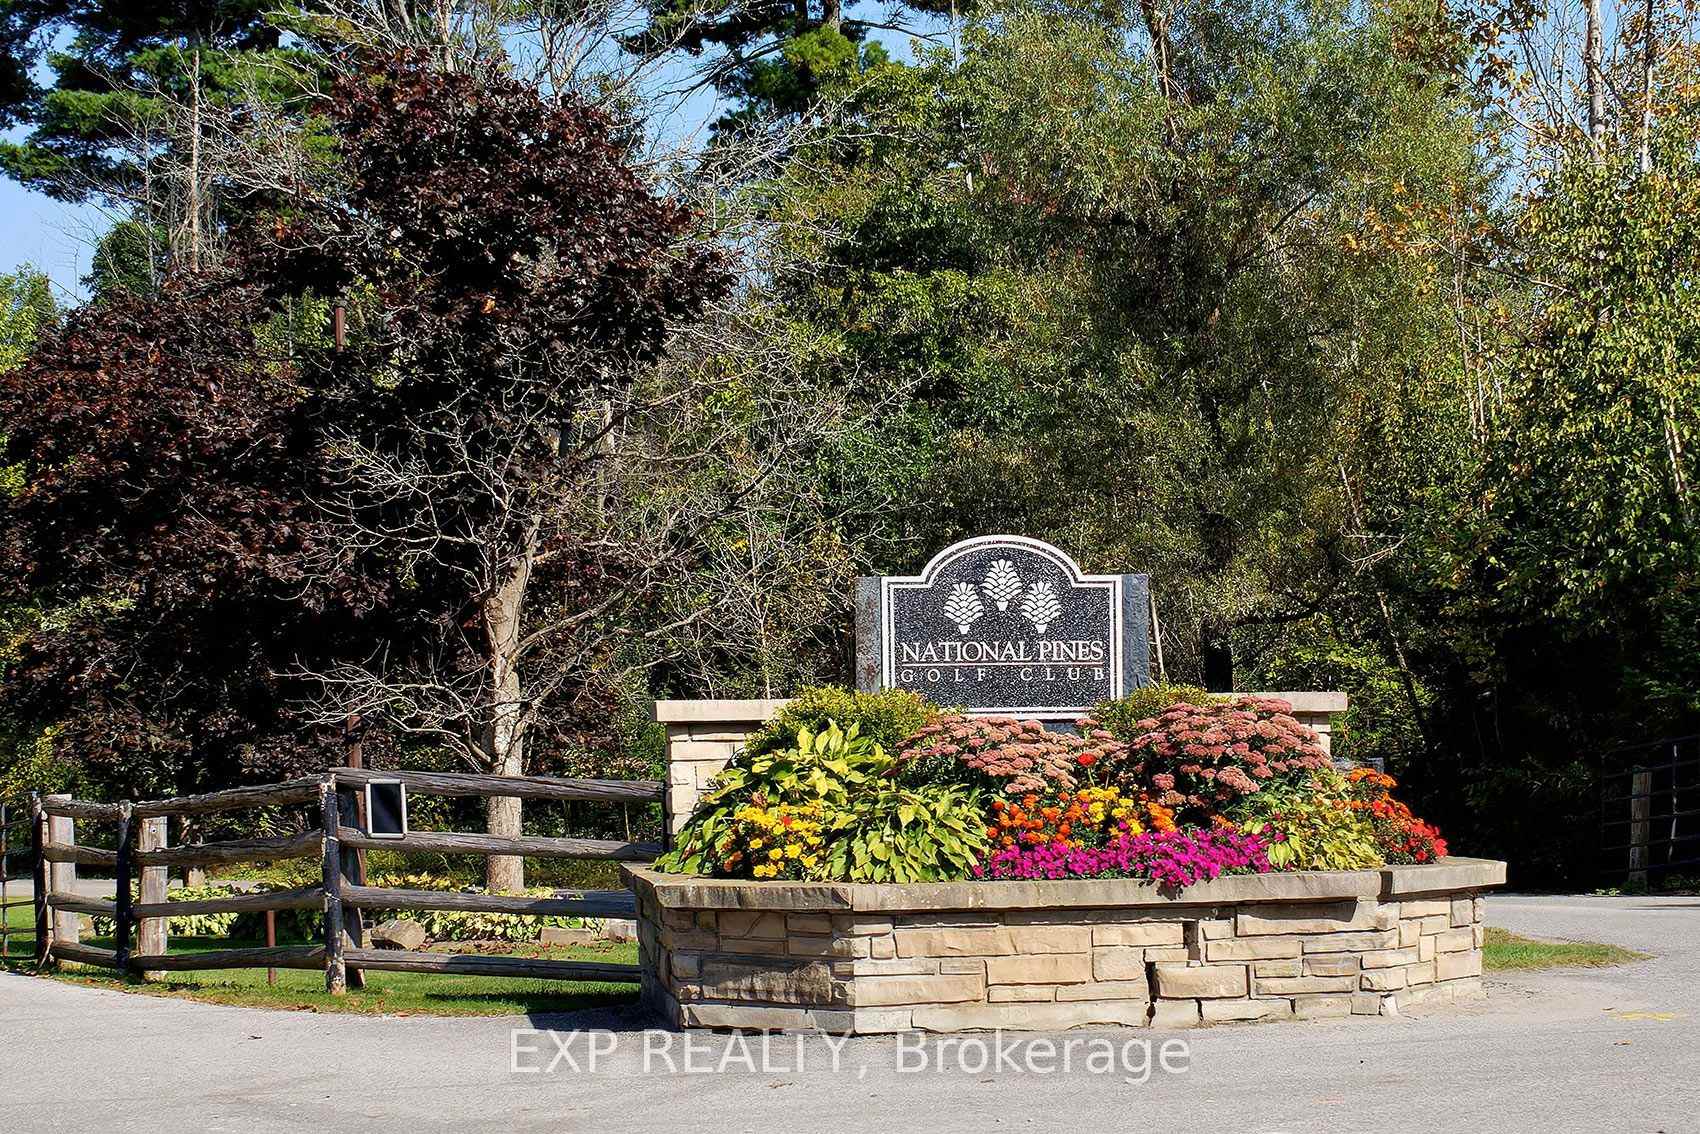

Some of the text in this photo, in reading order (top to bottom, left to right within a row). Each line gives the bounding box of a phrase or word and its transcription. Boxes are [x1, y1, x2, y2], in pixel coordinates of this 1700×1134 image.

[902, 641, 1103, 662] NATIONAL PINES
[902, 667, 1105, 682] GOLF CLUB
